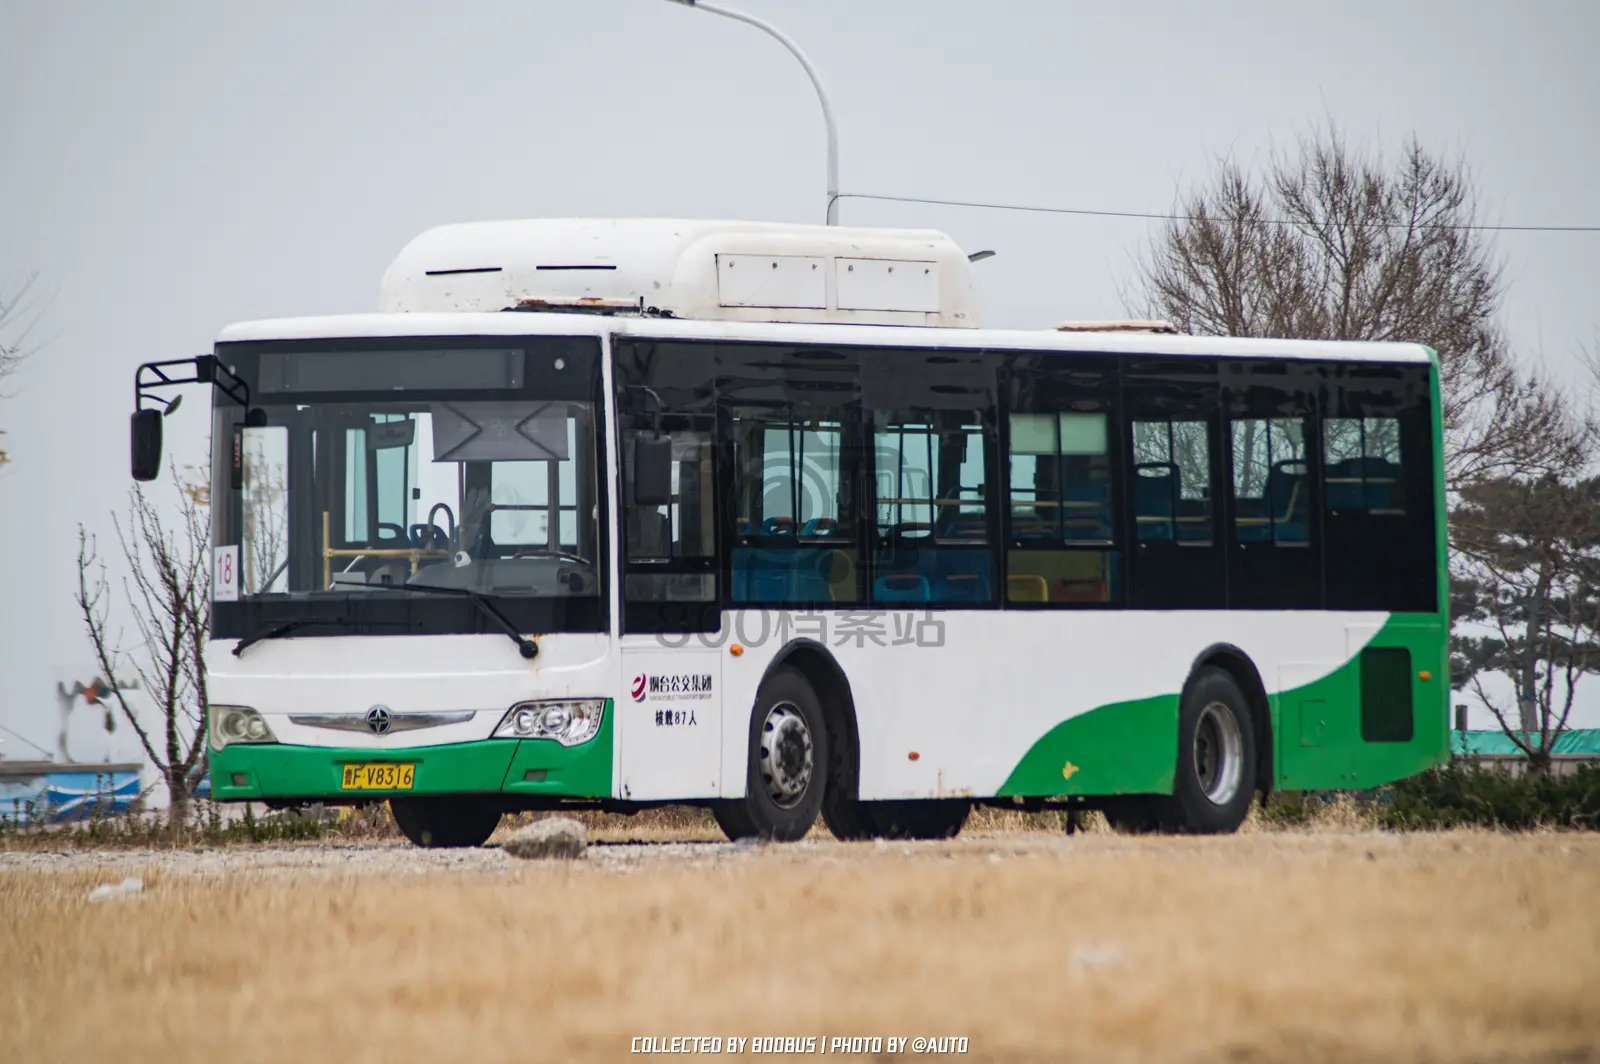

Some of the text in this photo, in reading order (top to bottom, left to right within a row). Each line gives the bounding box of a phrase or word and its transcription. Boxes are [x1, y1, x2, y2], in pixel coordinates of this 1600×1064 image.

[218, 553, 232, 585] 18
[649, 674, 712, 693] 烟台公交集团
